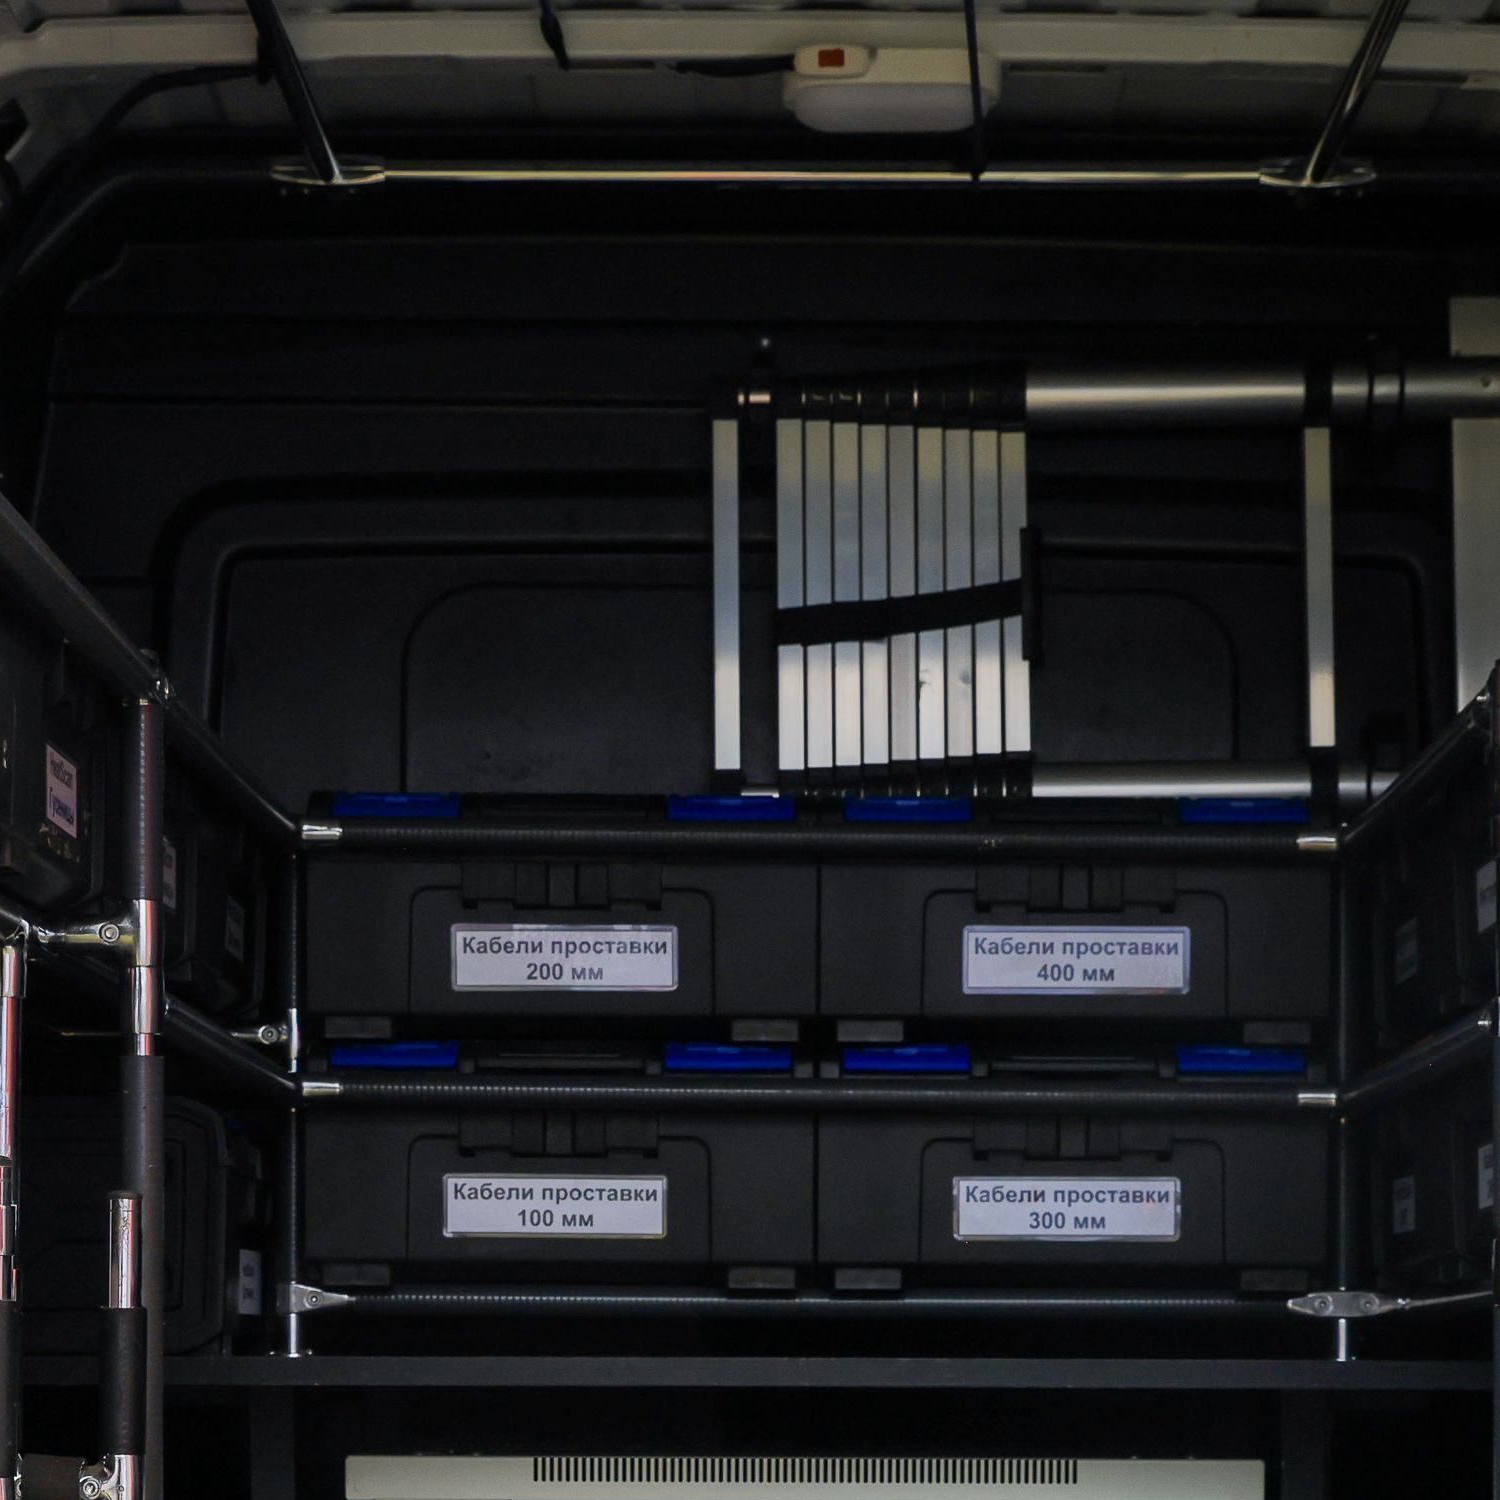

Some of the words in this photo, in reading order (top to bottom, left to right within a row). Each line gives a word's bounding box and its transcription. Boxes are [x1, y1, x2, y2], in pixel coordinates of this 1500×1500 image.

[462, 936, 543, 955] Кабели
[551, 940, 668, 959] проставки
[974, 937, 1055, 956] Кабели
[1062, 941, 1179, 960] проставки
[526, 962, 564, 981] 200
[571, 967, 604, 981] мм
[1037, 963, 1075, 982] 400
[1082, 968, 1115, 982] мм
[453, 1182, 534, 1201] Кабели
[542, 1187, 658, 1205] проставки
[965, 1185, 1046, 1203] Кабели
[1054, 1189, 1170, 1207] проставки
[517, 1209, 554, 1228] 100
[561, 1214, 594, 1227] мм
[1028, 1211, 1066, 1230] 300
[1073, 1216, 1106, 1230] мм
